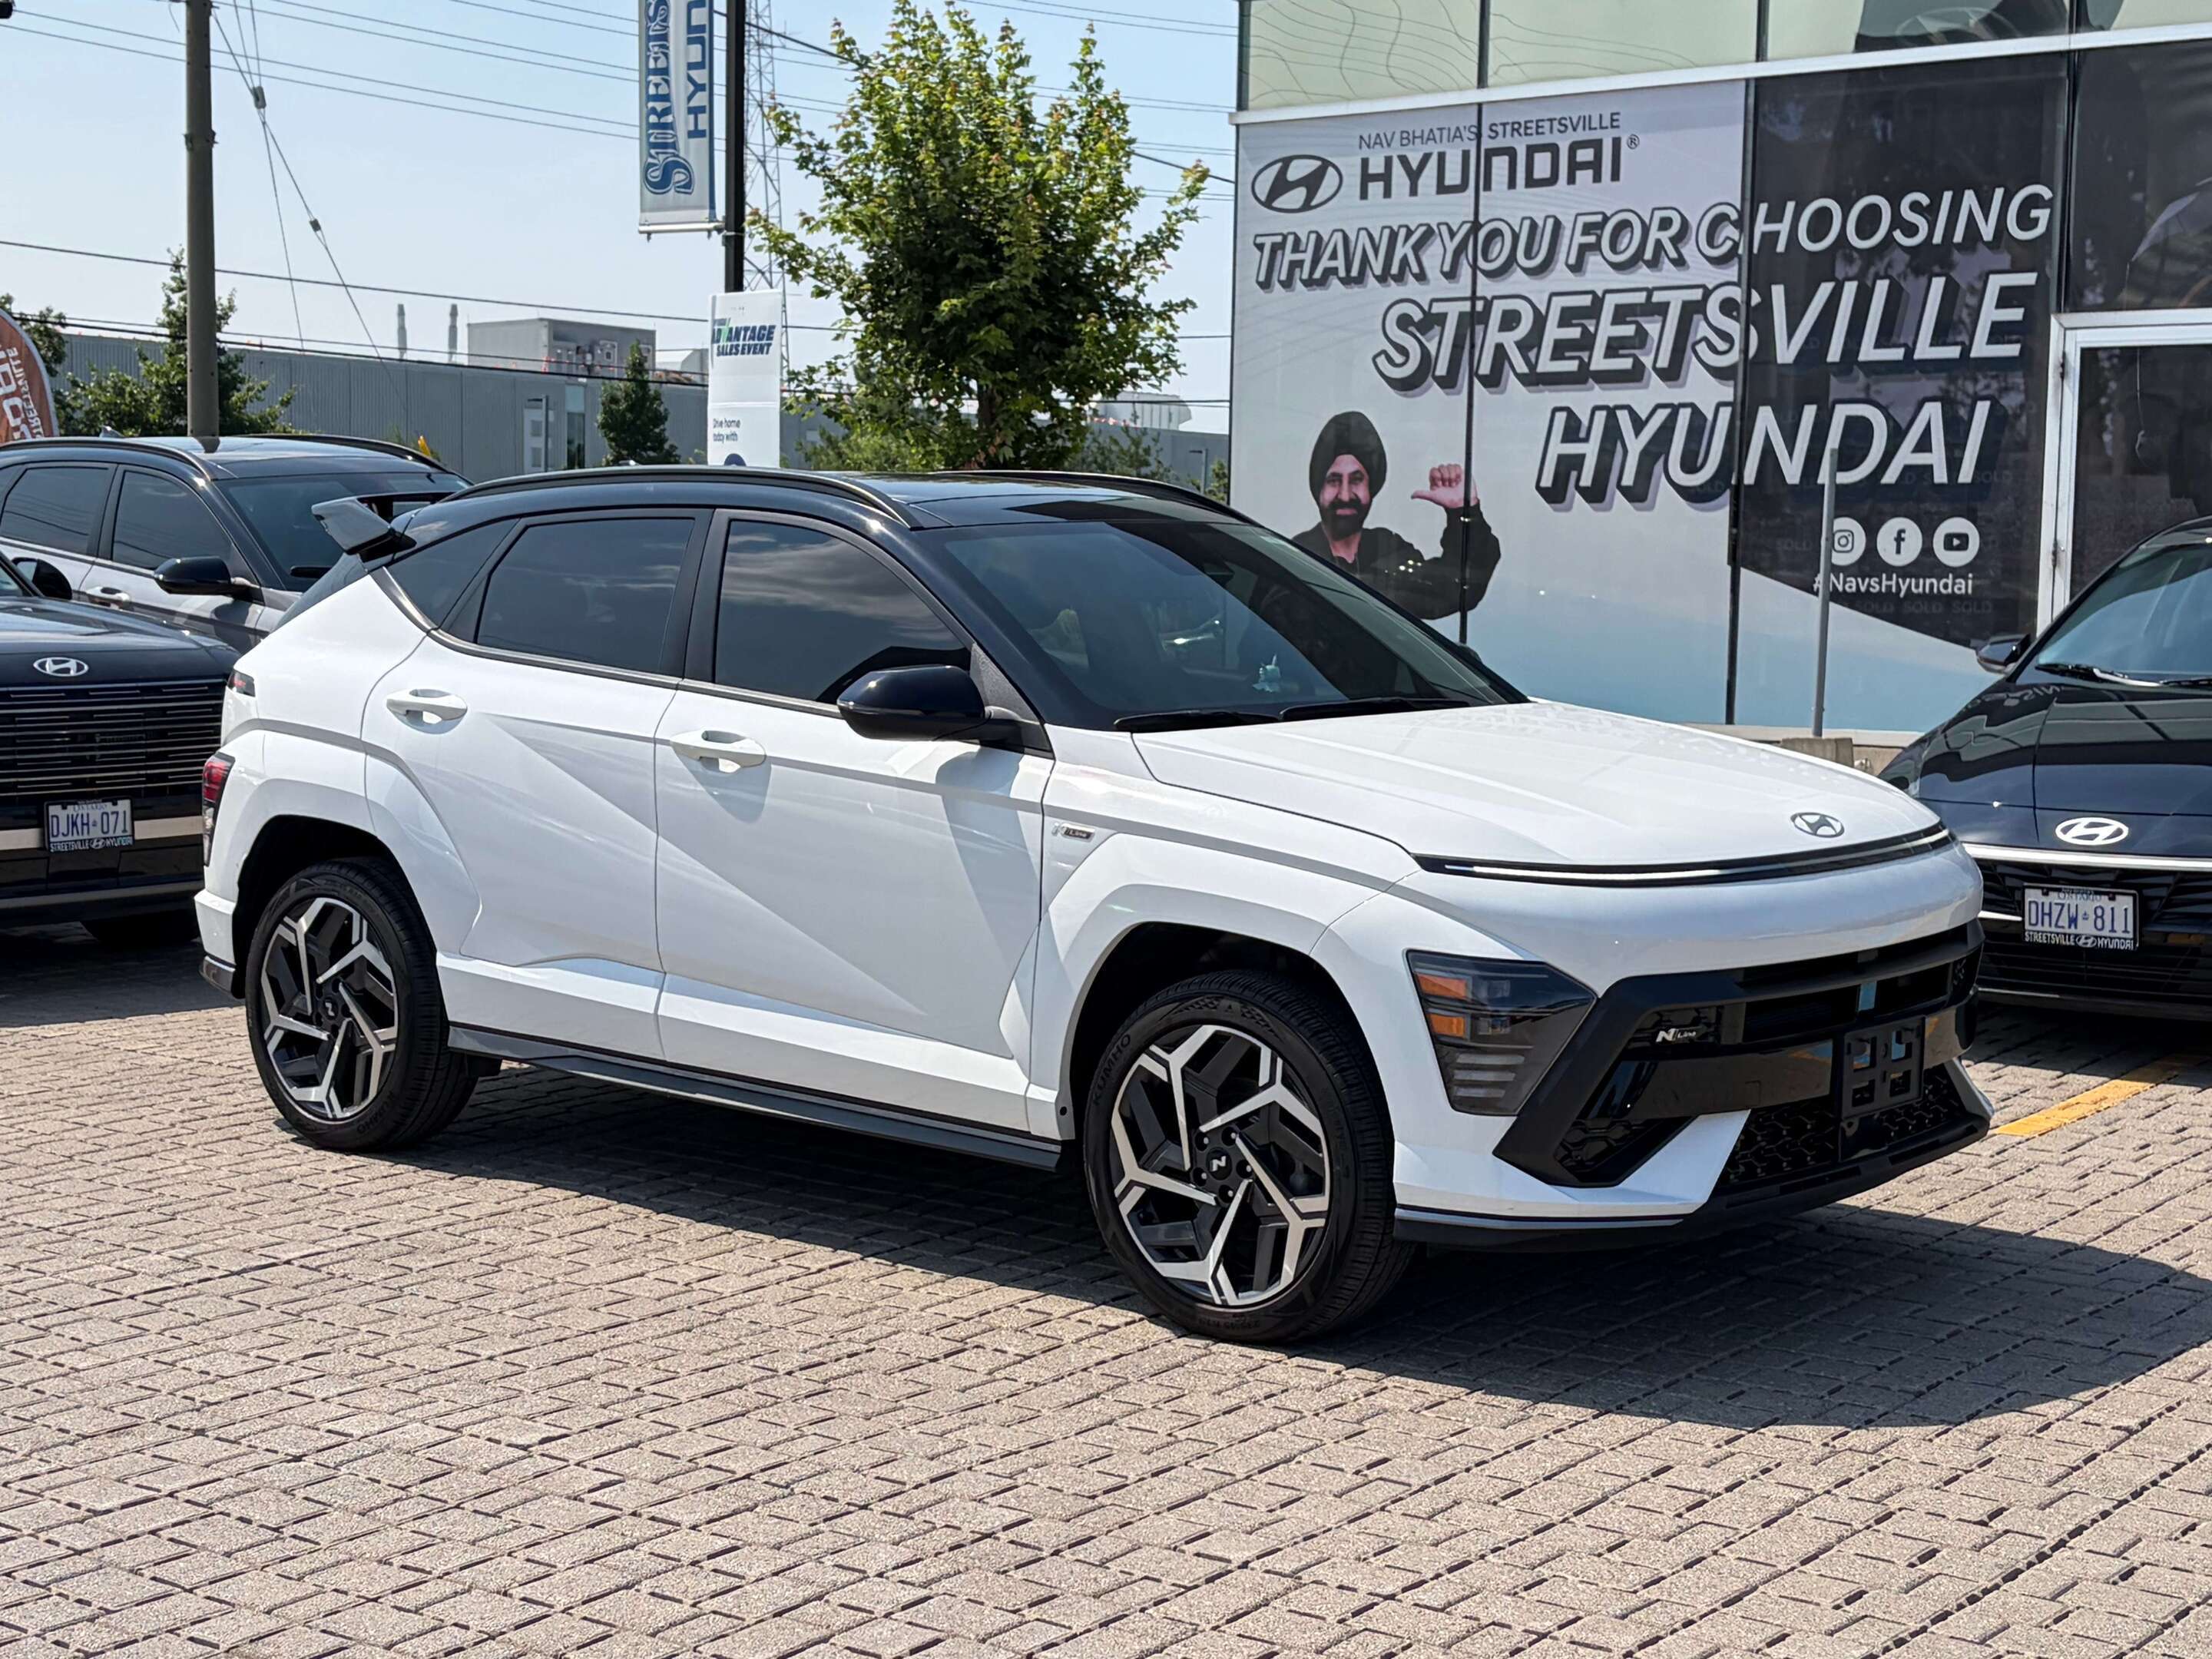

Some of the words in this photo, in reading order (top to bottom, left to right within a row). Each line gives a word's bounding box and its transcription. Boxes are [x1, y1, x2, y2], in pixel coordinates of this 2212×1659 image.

[1359, 131, 1396, 151] NAV
[1400, 124, 1479, 147] BHATIA'S
[1488, 112, 1621, 141] STREETSVILLE
[1253, 223, 1435, 290] THANK
[1436, 217, 1561, 284] YOU
[1565, 206, 1690, 276] FOR
[1694, 184, 2053, 267] CHOOSING
[740, 343, 773, 356] EVENT
[1373, 272, 2039, 394] STREETSVILLE
[1536, 399, 1992, 510] HYUNDAI
[51, 813, 90, 838] DJKH
[101, 810, 128, 834] 071
[2028, 899, 2078, 930] DHZW
[2094, 905, 2131, 934] 811
[2025, 931, 2075, 945] STREETSVILLE
[2098, 937, 2134, 951] HYUNDAI
